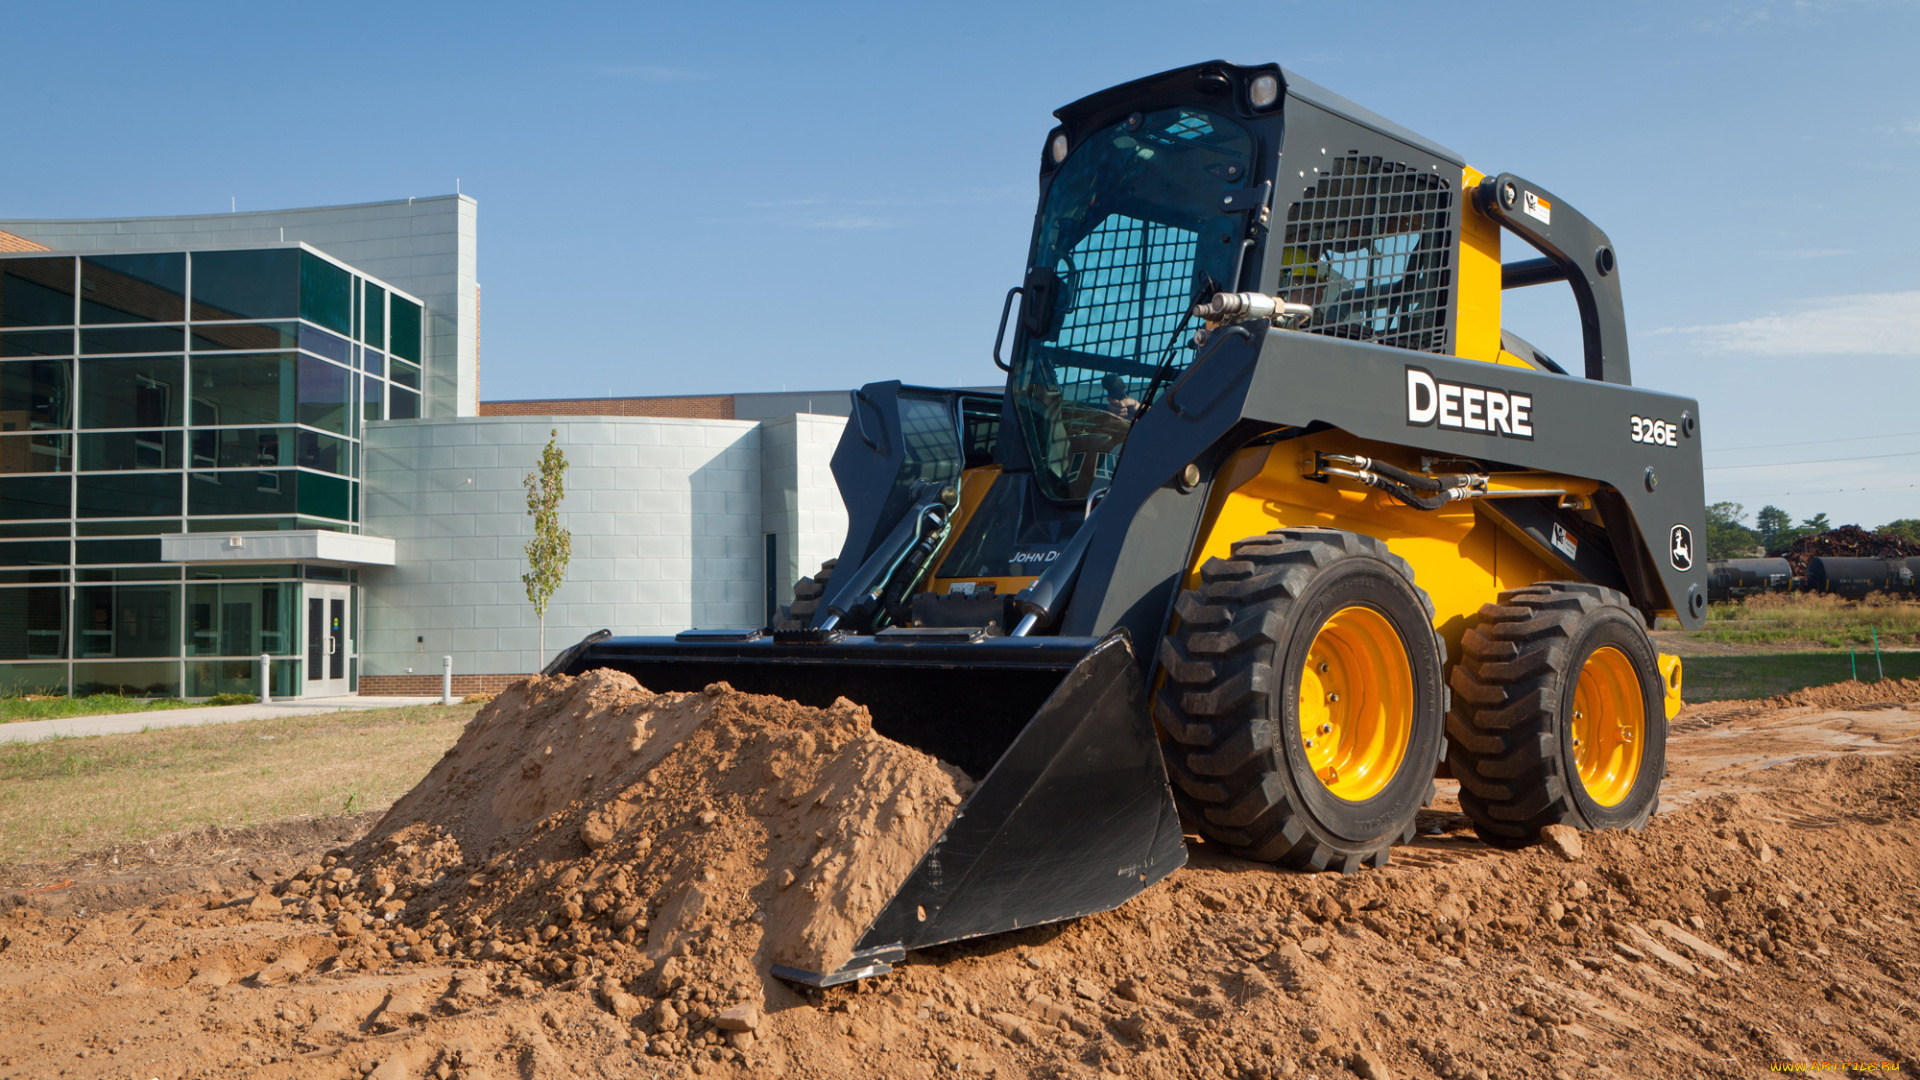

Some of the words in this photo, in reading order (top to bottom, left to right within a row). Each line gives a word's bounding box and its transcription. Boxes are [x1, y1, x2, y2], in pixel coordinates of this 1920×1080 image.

[1407, 368, 1533, 437] DEERE
[1631, 415, 1677, 447] 326E
[1009, 552, 1045, 563] JOHN
